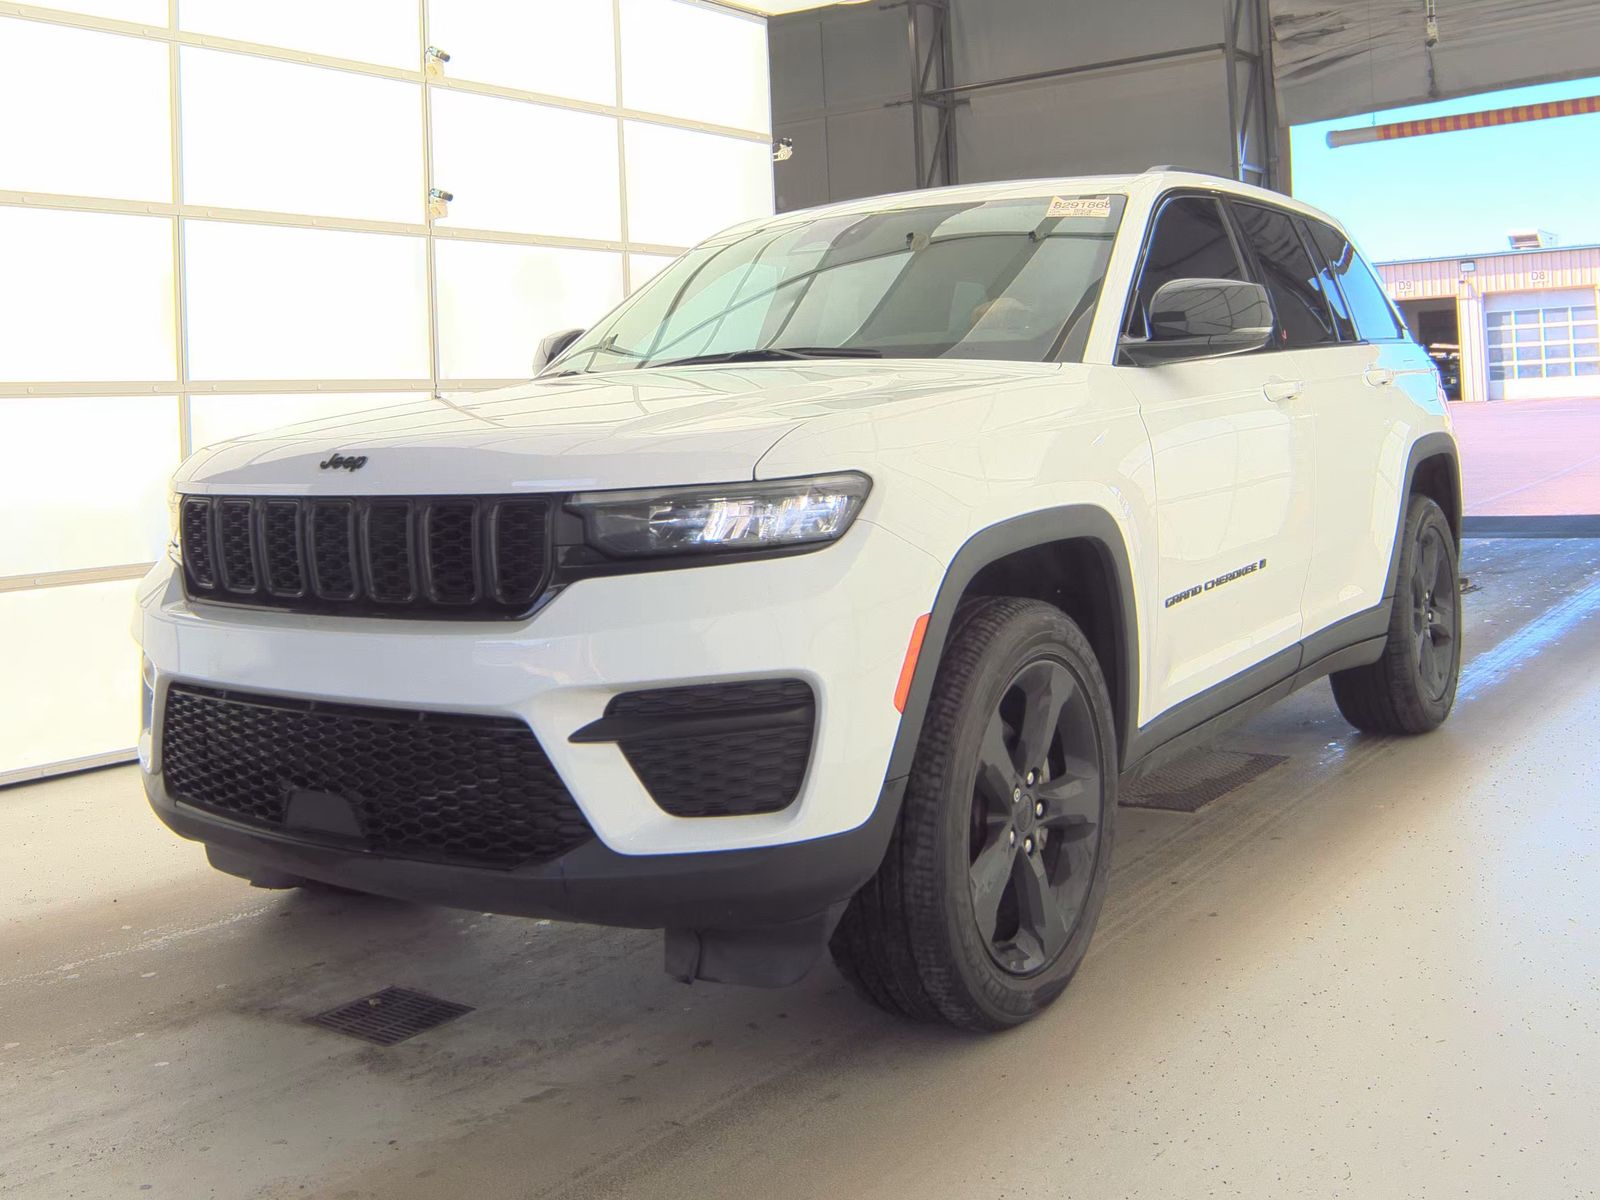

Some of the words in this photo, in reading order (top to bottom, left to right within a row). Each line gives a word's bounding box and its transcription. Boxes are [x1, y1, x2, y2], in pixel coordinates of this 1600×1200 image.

[1531, 271, 1545, 281] D8
[1398, 279, 1411, 290] D9
[320, 453, 368, 472] Jeep
[1165, 584, 1202, 608] GRAND
[1204, 562, 1258, 591] CHEROKEE
